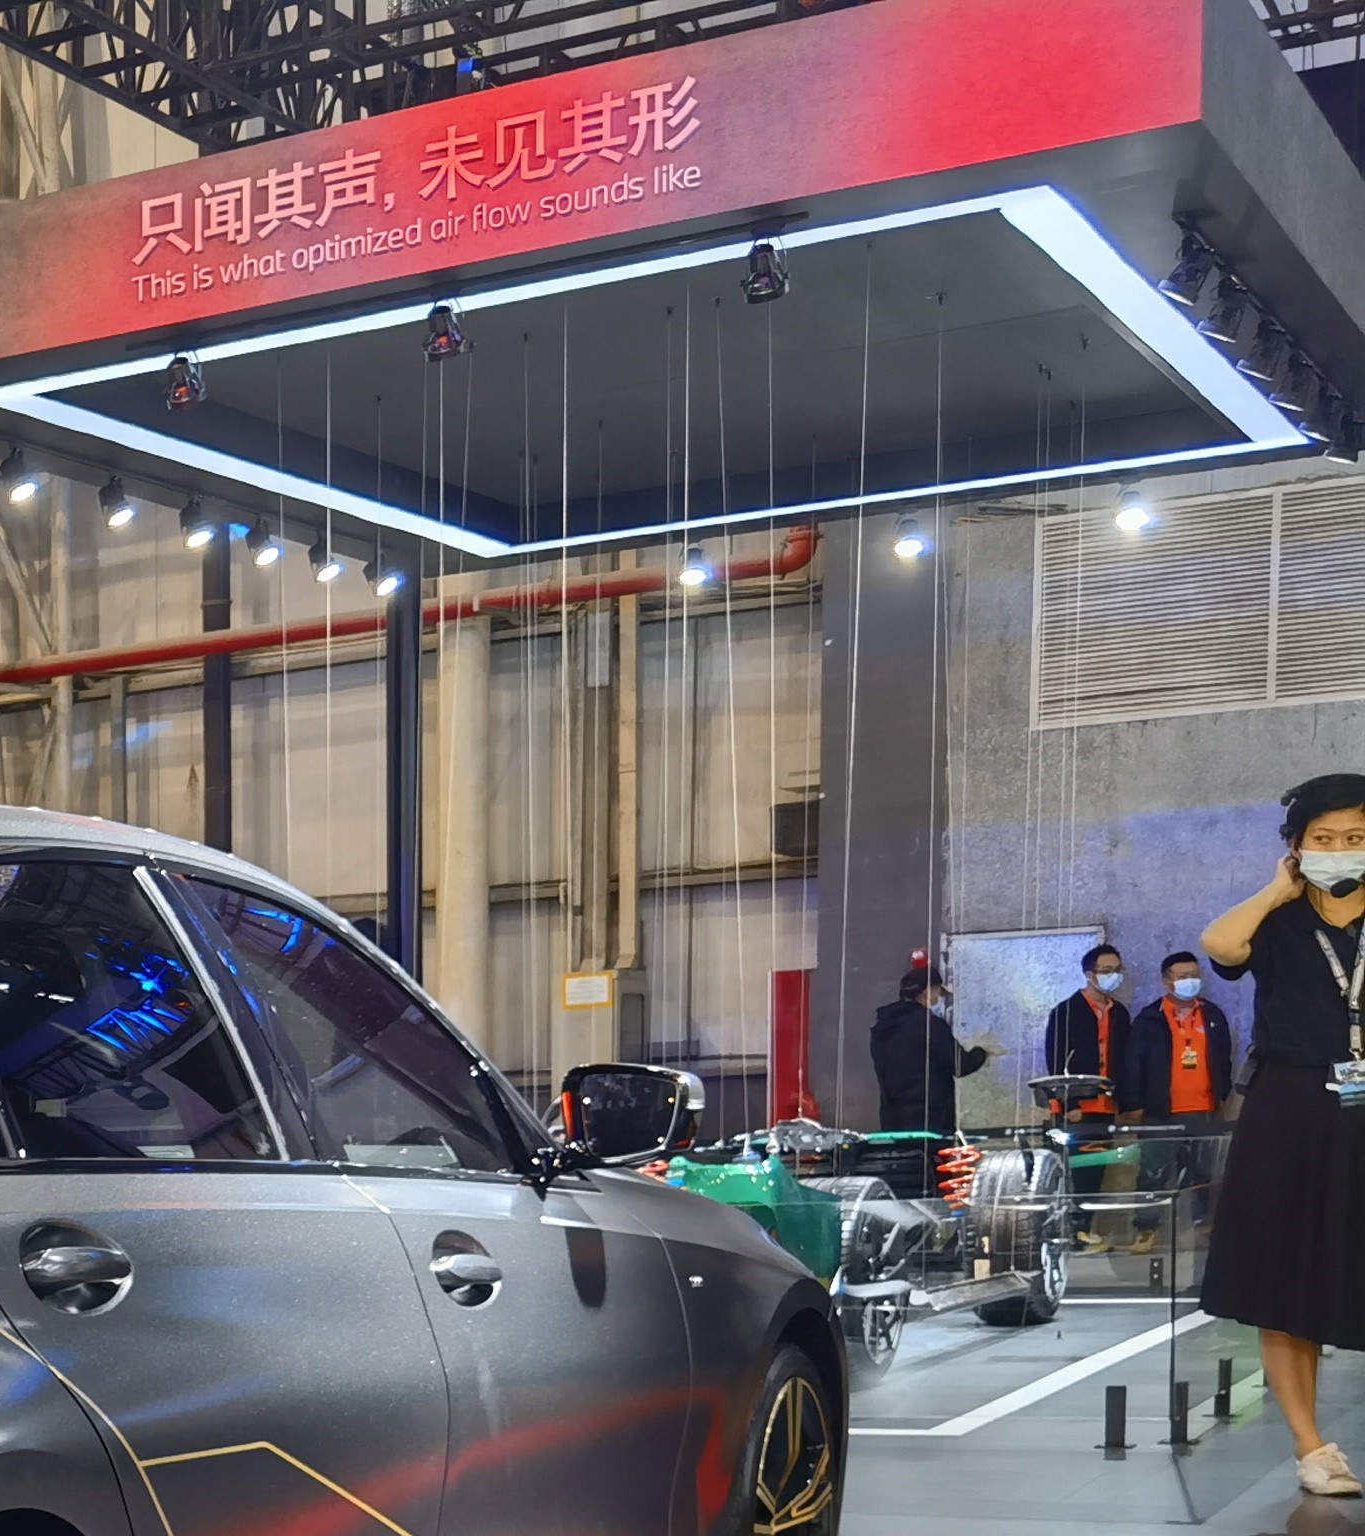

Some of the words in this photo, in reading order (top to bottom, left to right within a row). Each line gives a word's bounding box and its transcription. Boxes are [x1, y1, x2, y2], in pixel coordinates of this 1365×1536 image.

[131, 270, 186, 301] This
[193, 263, 214, 290] is
[219, 249, 286, 284] what
[292, 217, 422, 272] optimized
[430, 210, 466, 241] air
[472, 200, 532, 232] flow
[540, 172, 645, 219] sounds
[653, 163, 702, 195] like
